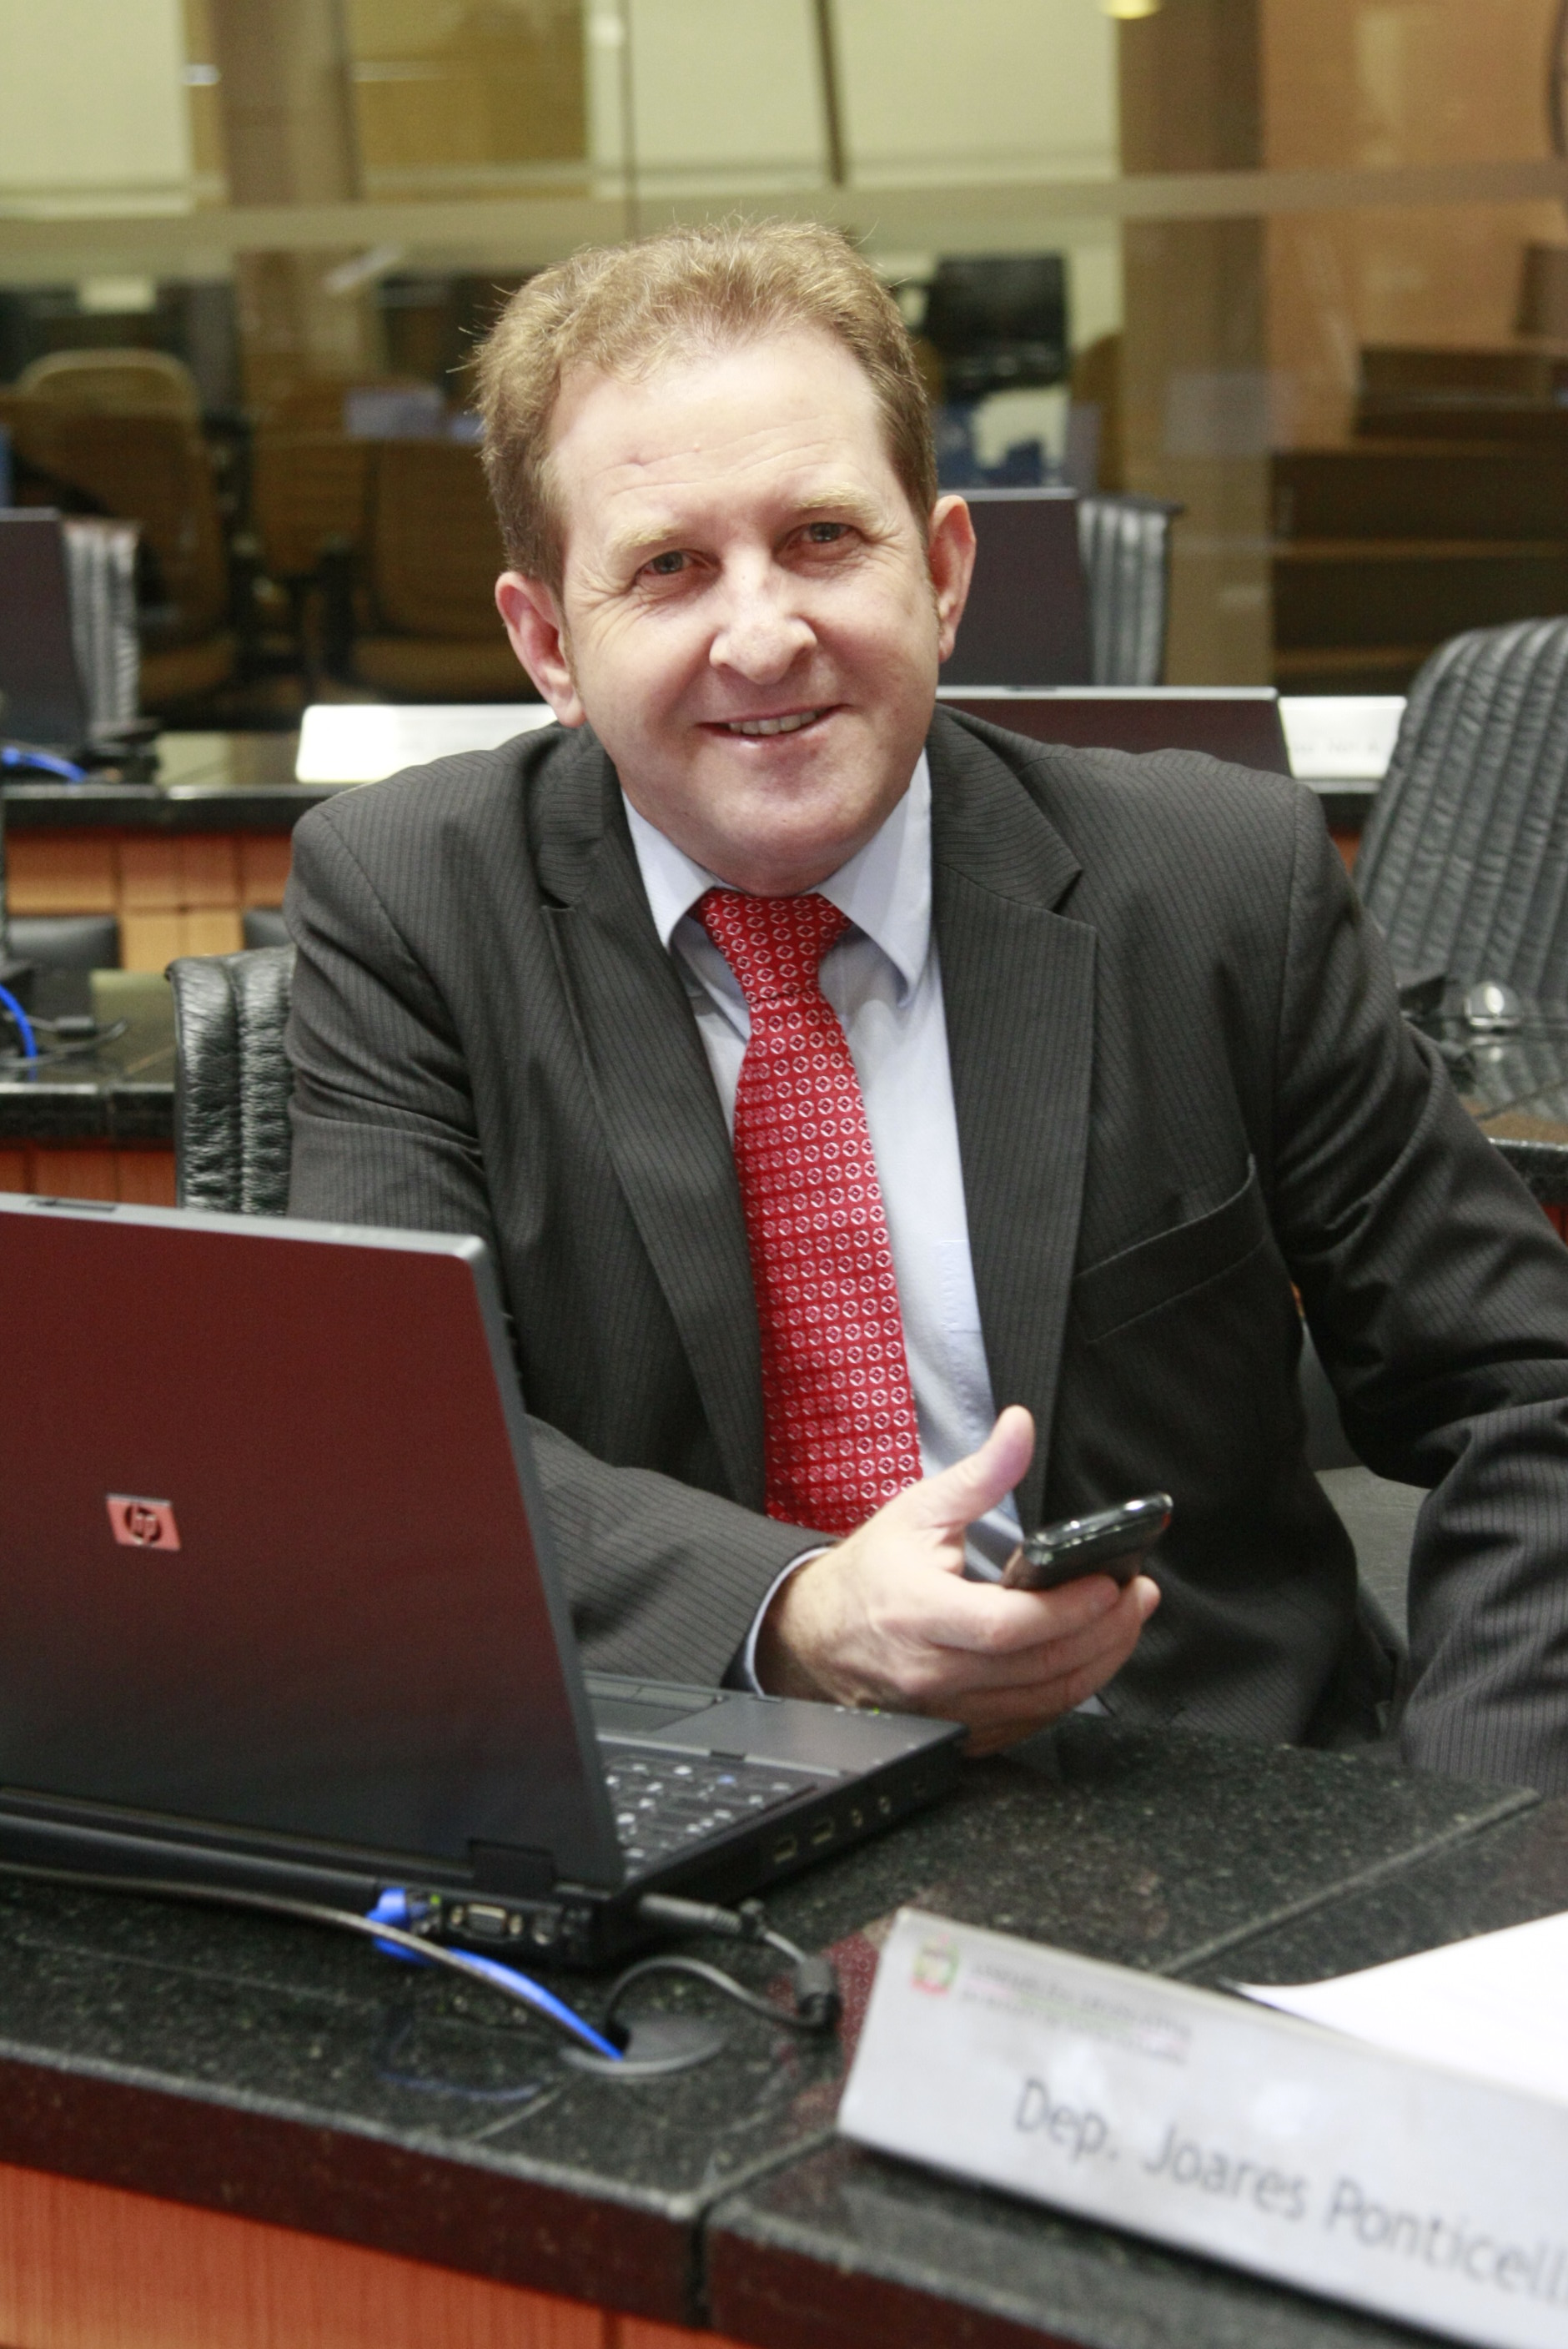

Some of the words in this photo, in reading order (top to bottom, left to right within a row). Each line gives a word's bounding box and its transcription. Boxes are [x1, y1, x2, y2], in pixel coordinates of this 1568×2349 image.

[1015, 2077, 1118, 2162] Dep.
[1143, 2122, 1309, 2221] Joares
[1324, 2175, 1568, 2307] Ponticell
